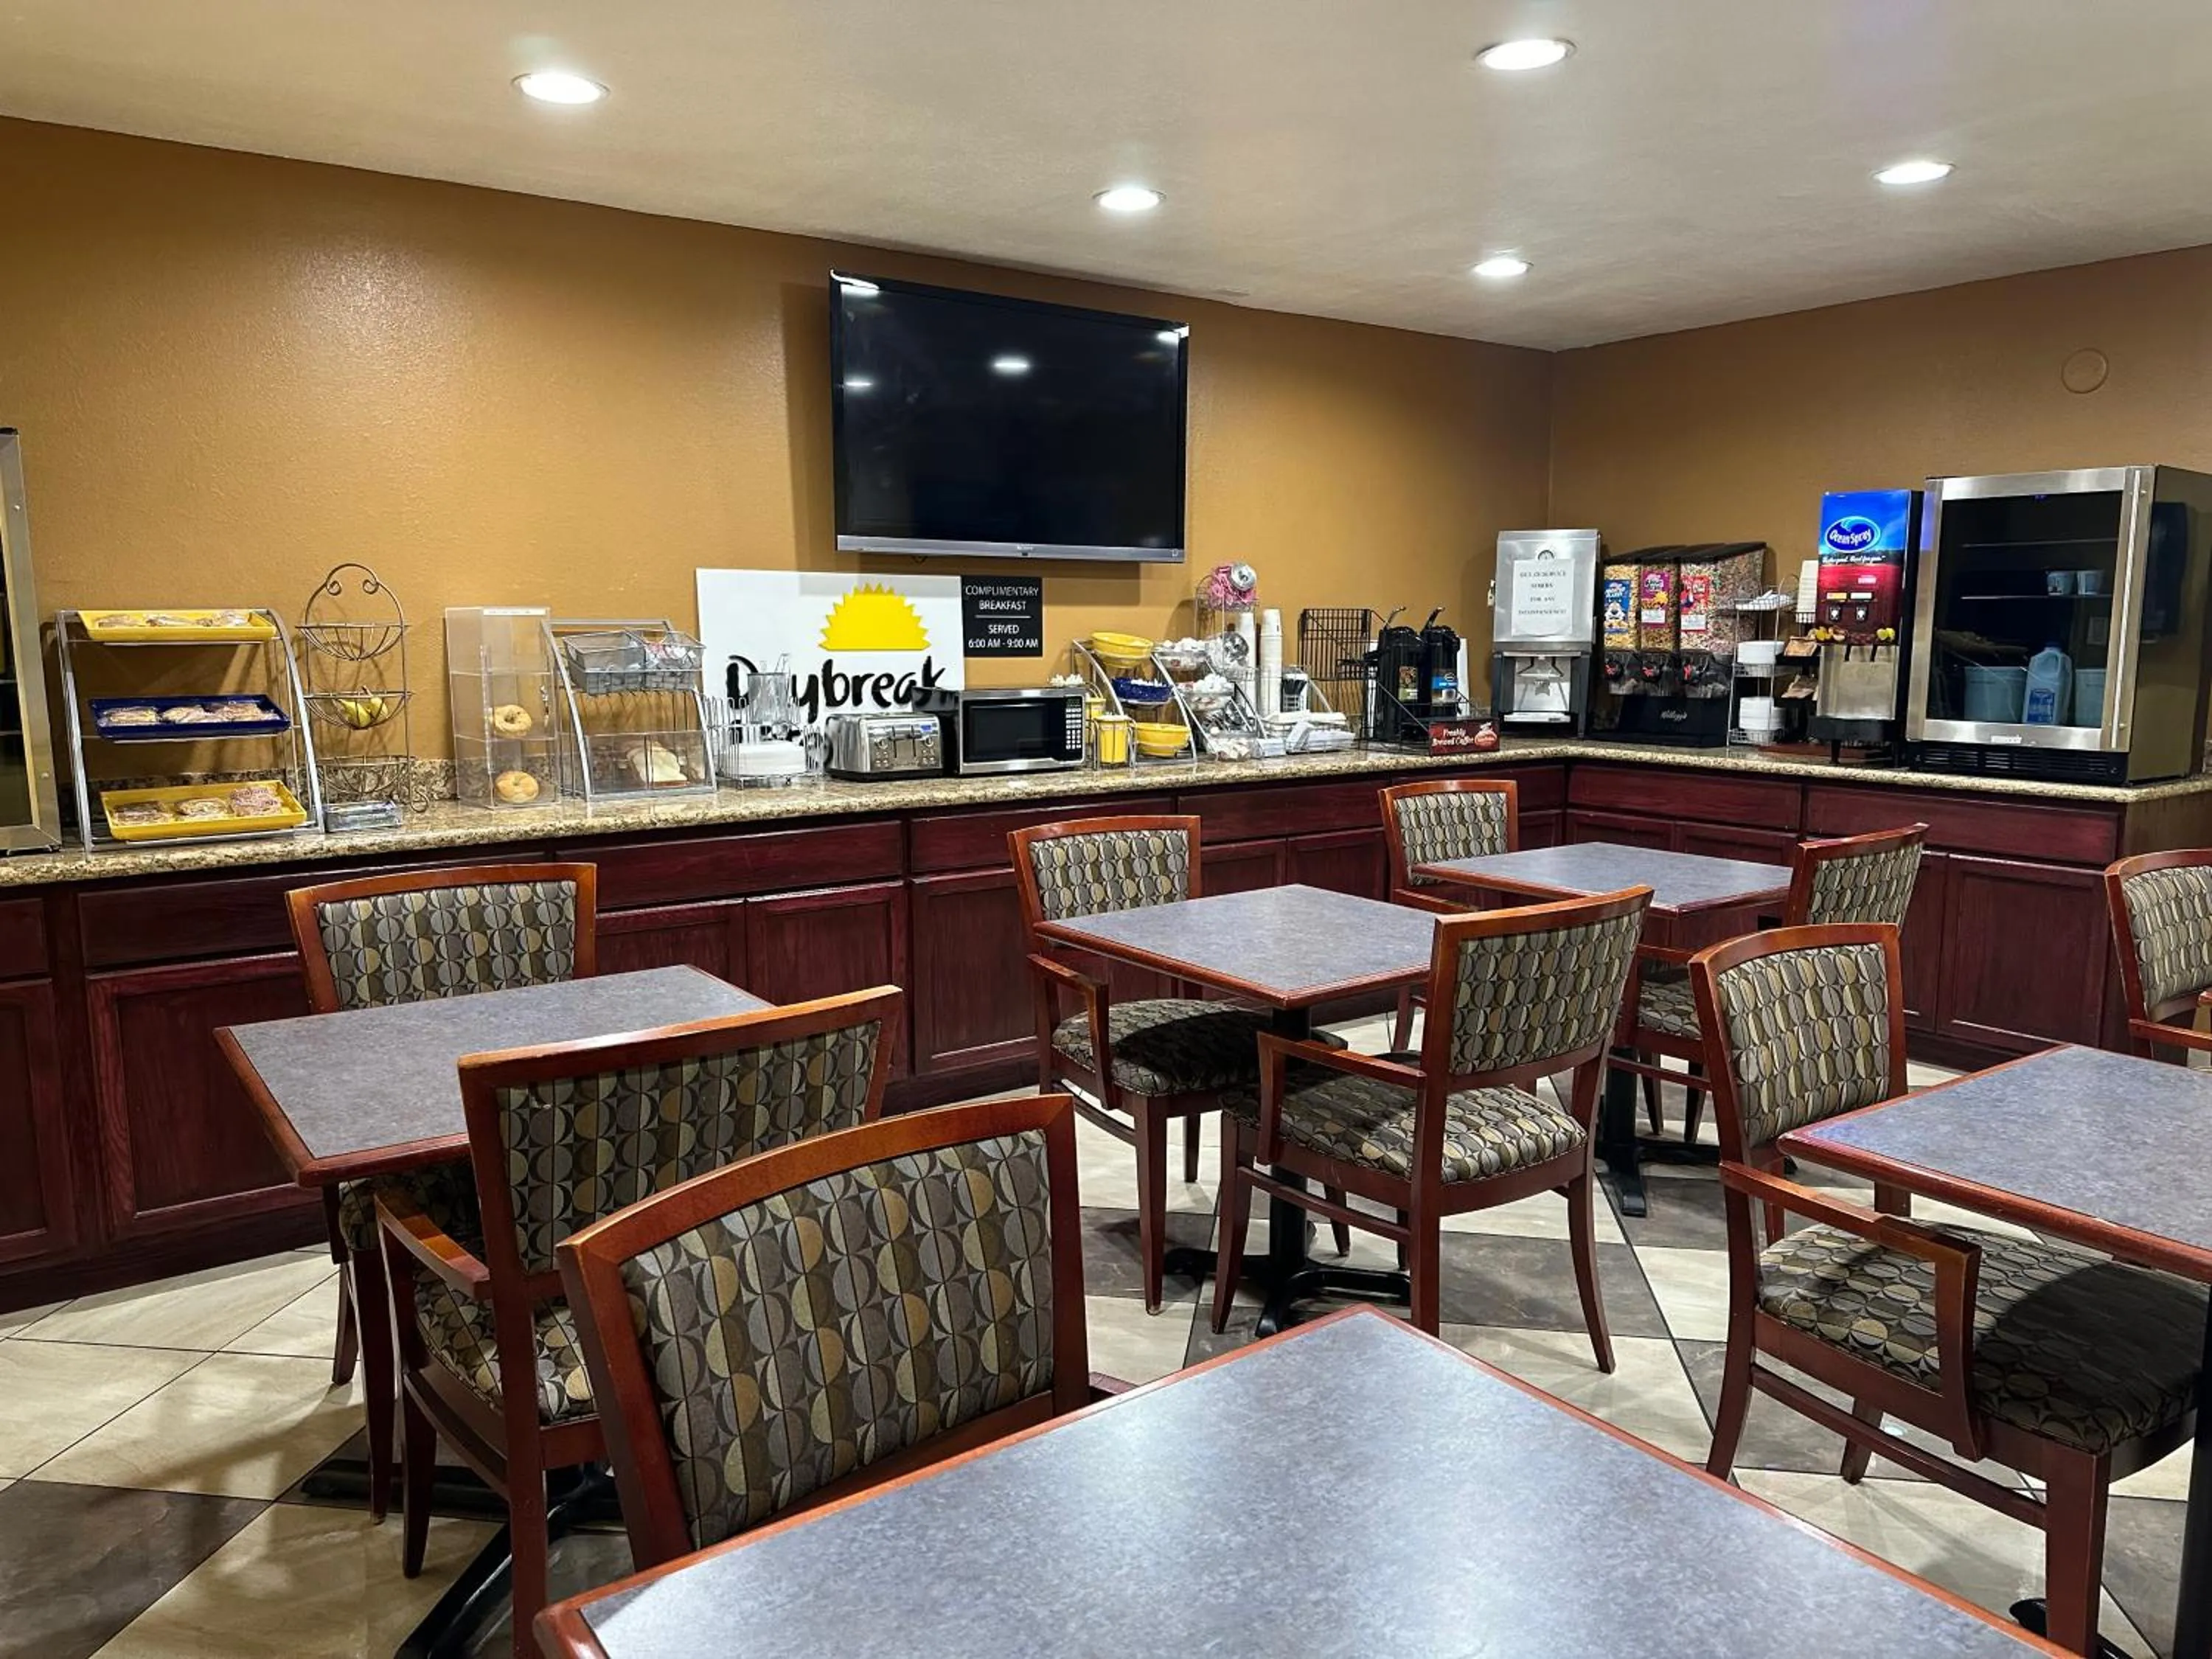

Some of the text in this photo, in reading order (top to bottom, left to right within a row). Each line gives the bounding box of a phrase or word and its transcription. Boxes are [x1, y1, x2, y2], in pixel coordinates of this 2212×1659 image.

[1829, 529, 1871, 546] Ocean Spray
[965, 585, 1039, 596] COMPLIMENTARY
[978, 599, 1026, 611] BREAKFAST
[988, 625, 1020, 634] SERVED
[968, 638, 986, 648] 6:00
[987, 638, 1001, 647] AM
[1006, 638, 1024, 648] 9:00
[1025, 638, 1039, 647] AM
[726, 655, 946, 724] Dybreak
